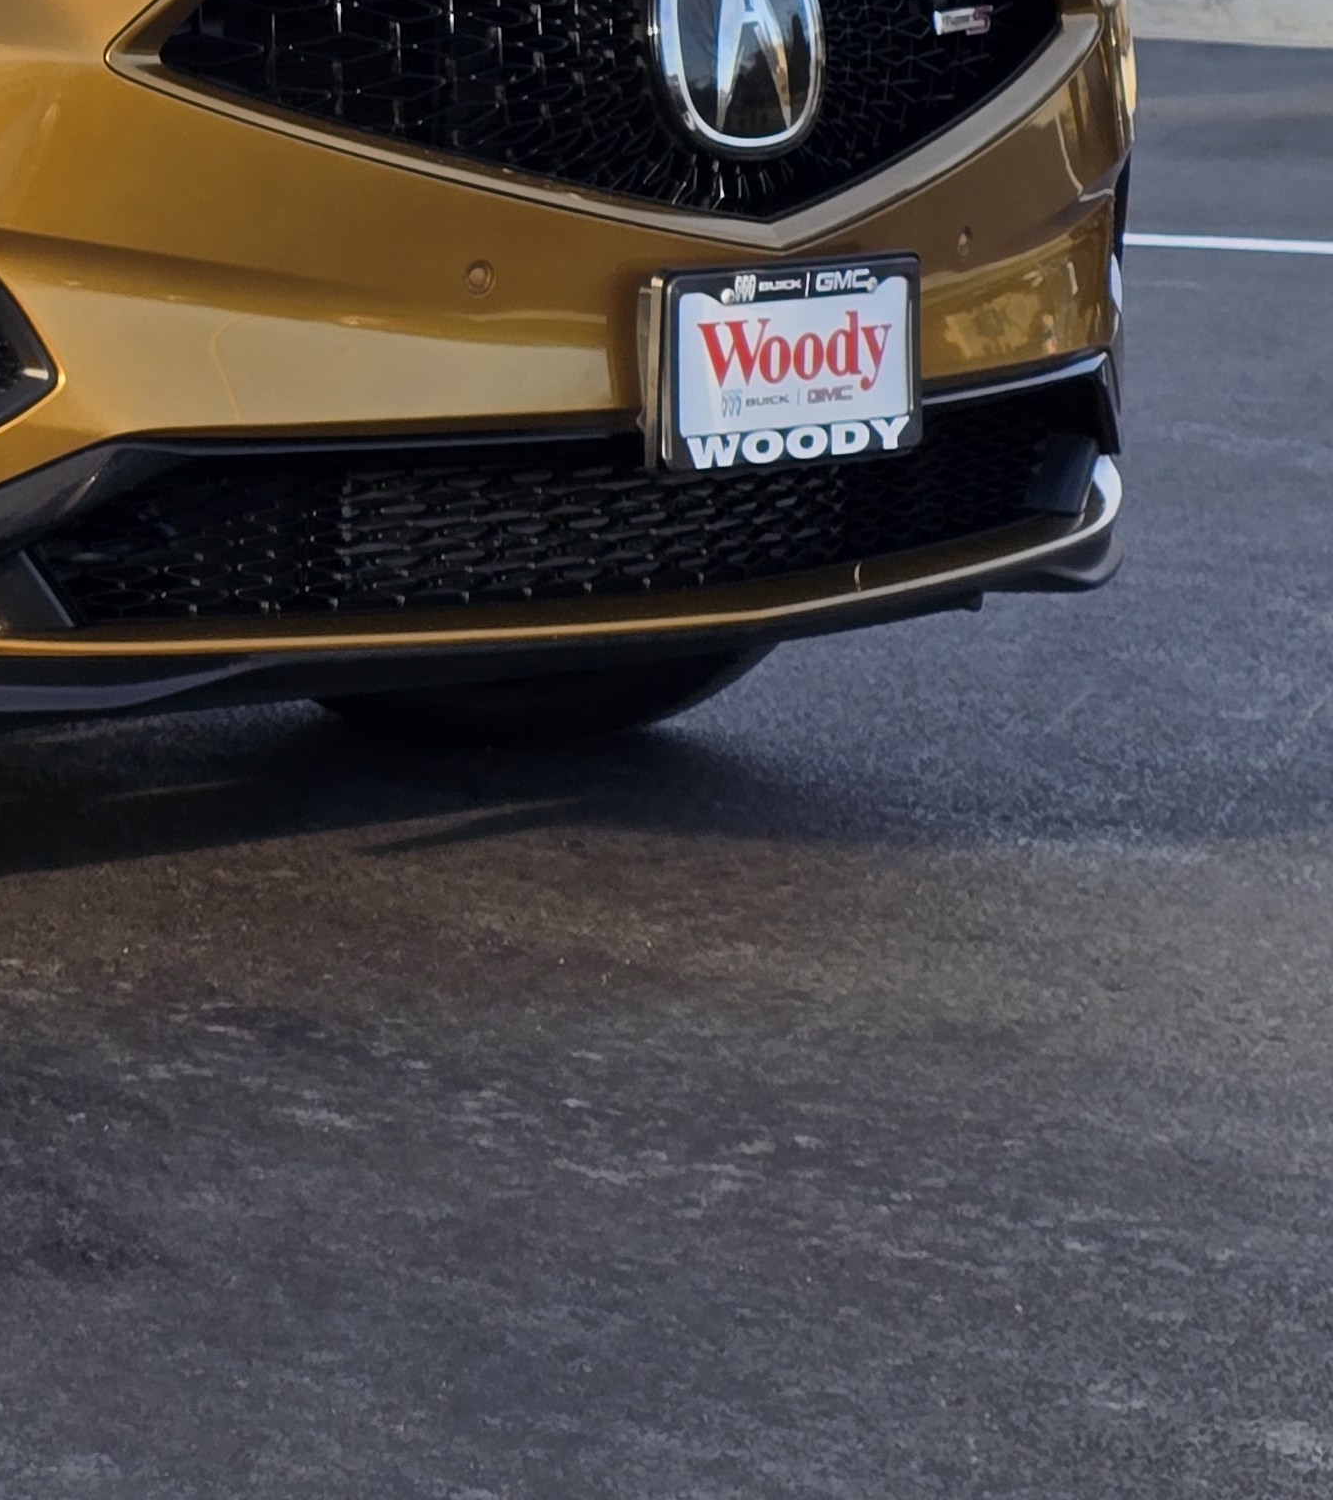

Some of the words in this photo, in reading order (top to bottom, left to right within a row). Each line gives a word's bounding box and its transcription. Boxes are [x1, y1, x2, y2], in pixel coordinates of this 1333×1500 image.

[815, 268, 871, 292] GMC
[696, 310, 893, 391] Woody
[745, 393, 790, 408] BUICK
[807, 384, 854, 404] GMC
[685, 415, 911, 470] WOODY
